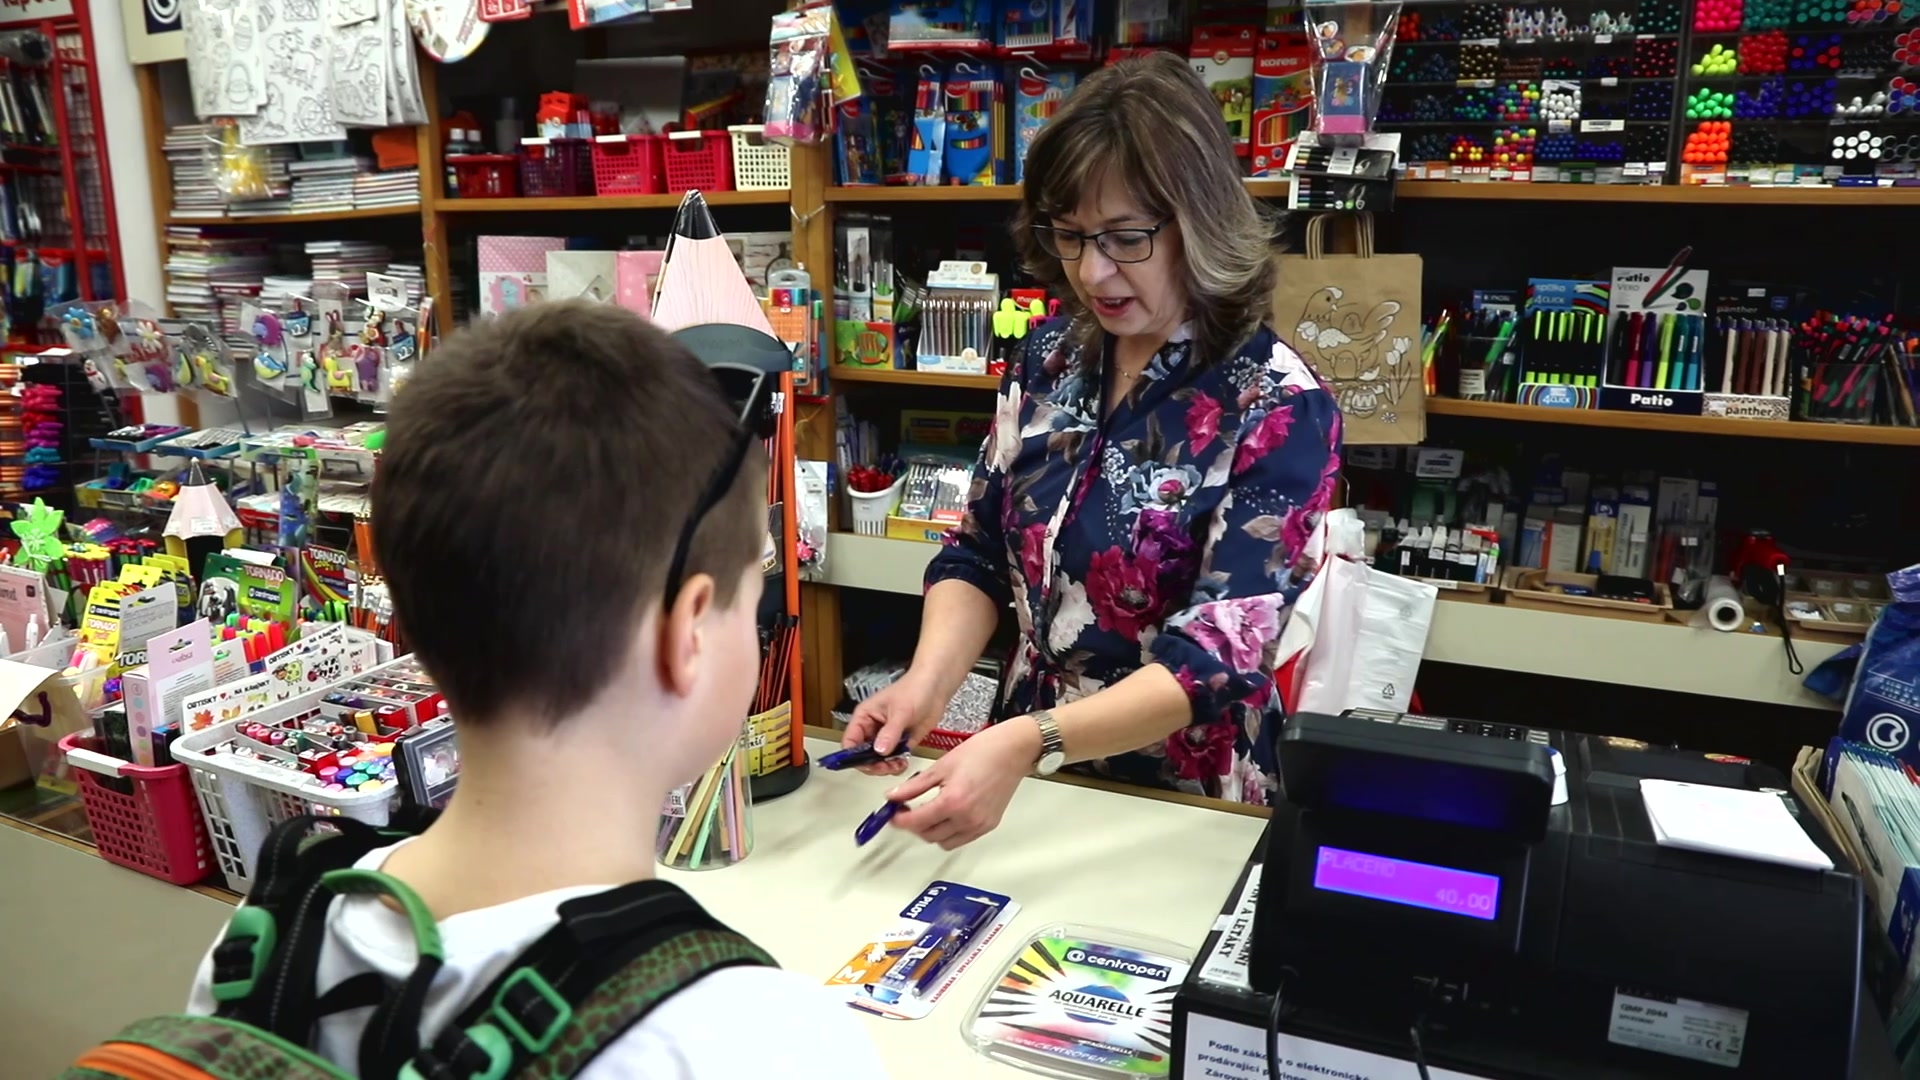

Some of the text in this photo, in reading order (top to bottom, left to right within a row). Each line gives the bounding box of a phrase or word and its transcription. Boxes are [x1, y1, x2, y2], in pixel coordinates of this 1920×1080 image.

[1630, 393, 1673, 407] Patio
[1725, 406, 1773, 418] panther
[120, 651, 149, 667] TOR
[906, 896, 933, 918] PILOT
[1087, 953, 1168, 979] centropen
[1048, 989, 1147, 1018] AQUARELLE
[1208, 1040, 1239, 1053] Podle
